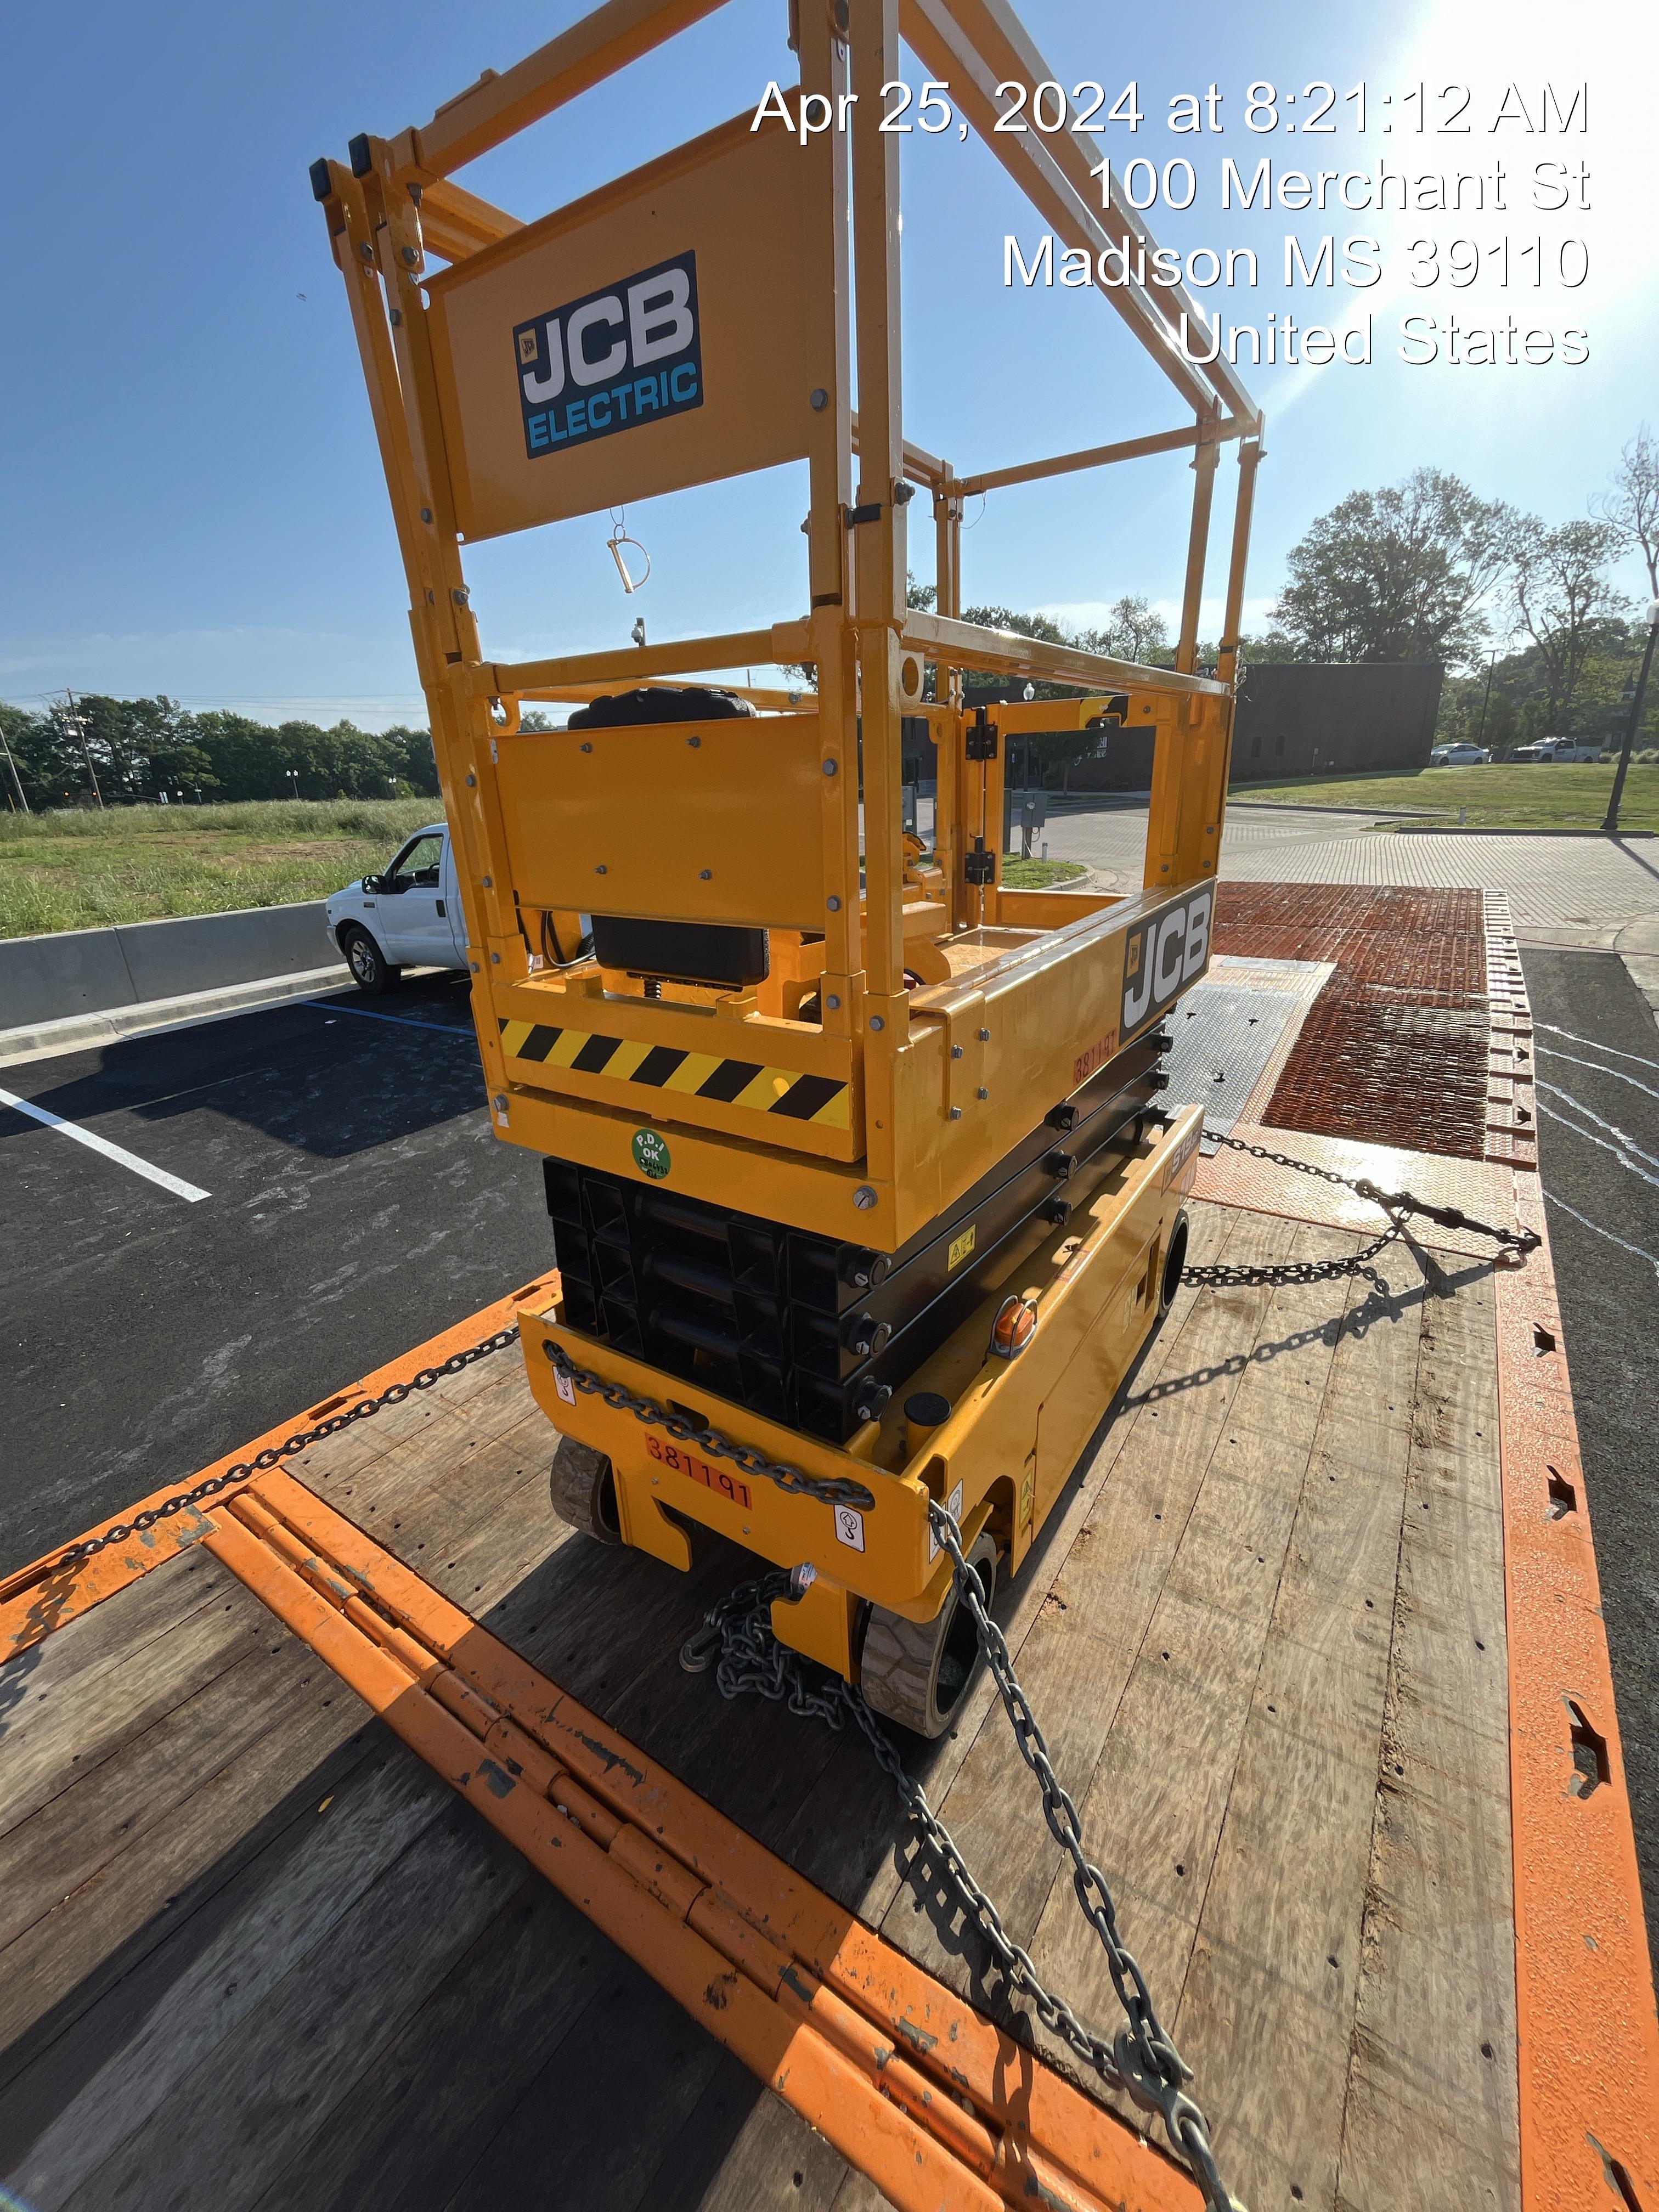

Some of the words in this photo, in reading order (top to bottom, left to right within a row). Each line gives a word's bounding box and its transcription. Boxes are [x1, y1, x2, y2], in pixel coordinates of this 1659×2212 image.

[523, 268, 694, 404] JCB
[528, 362, 698, 449] ELECTRIC
[1124, 892, 1211, 1029] JCB
[642, 1147, 660, 1161] OK
[648, 1436, 748, 1508] 381191
